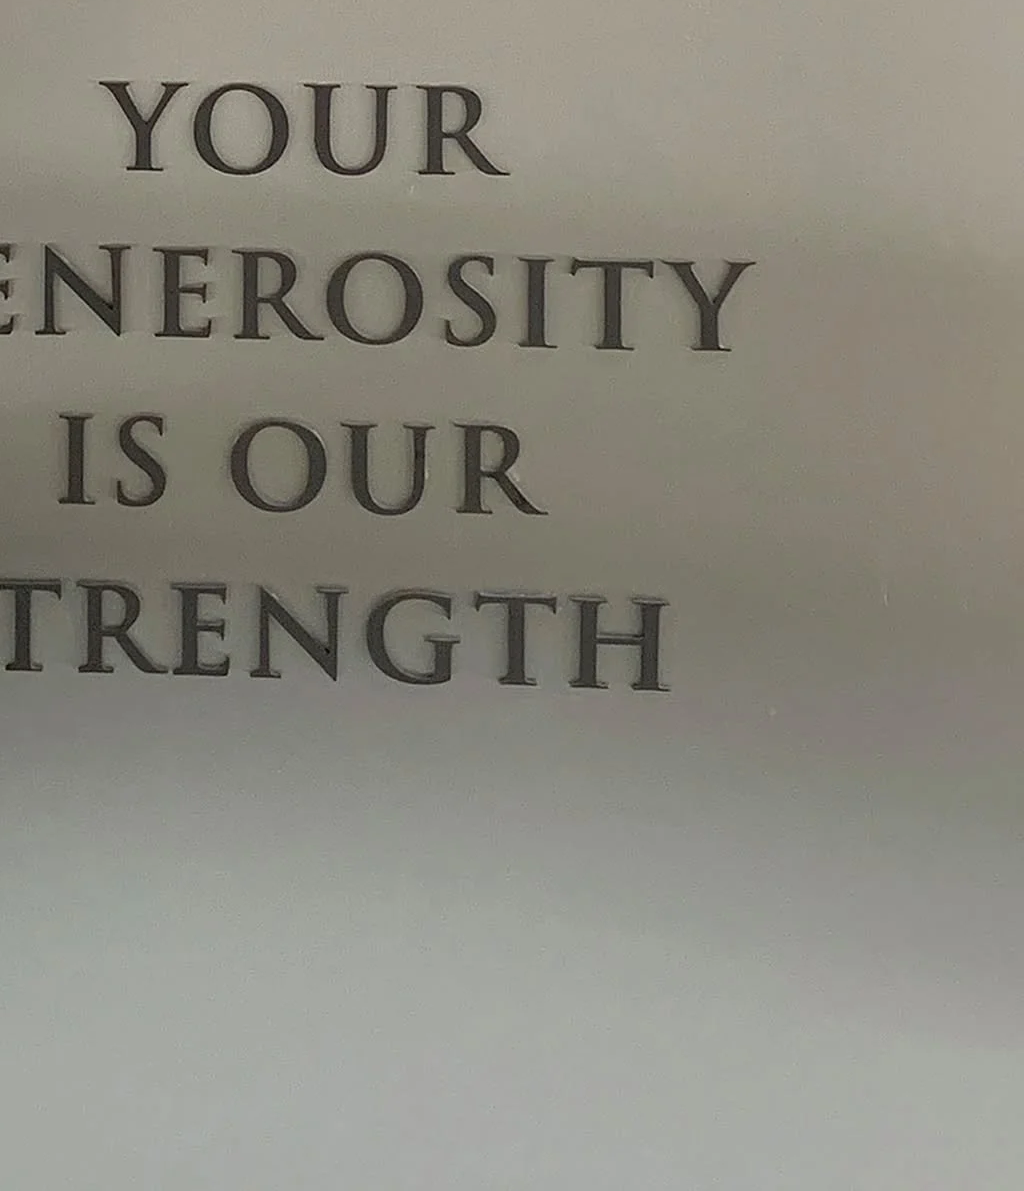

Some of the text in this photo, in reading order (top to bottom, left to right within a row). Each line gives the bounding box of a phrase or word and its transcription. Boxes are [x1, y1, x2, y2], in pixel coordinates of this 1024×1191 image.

[98, 81, 510, 176] YOUR
[56, 411, 549, 517] IS OUR
